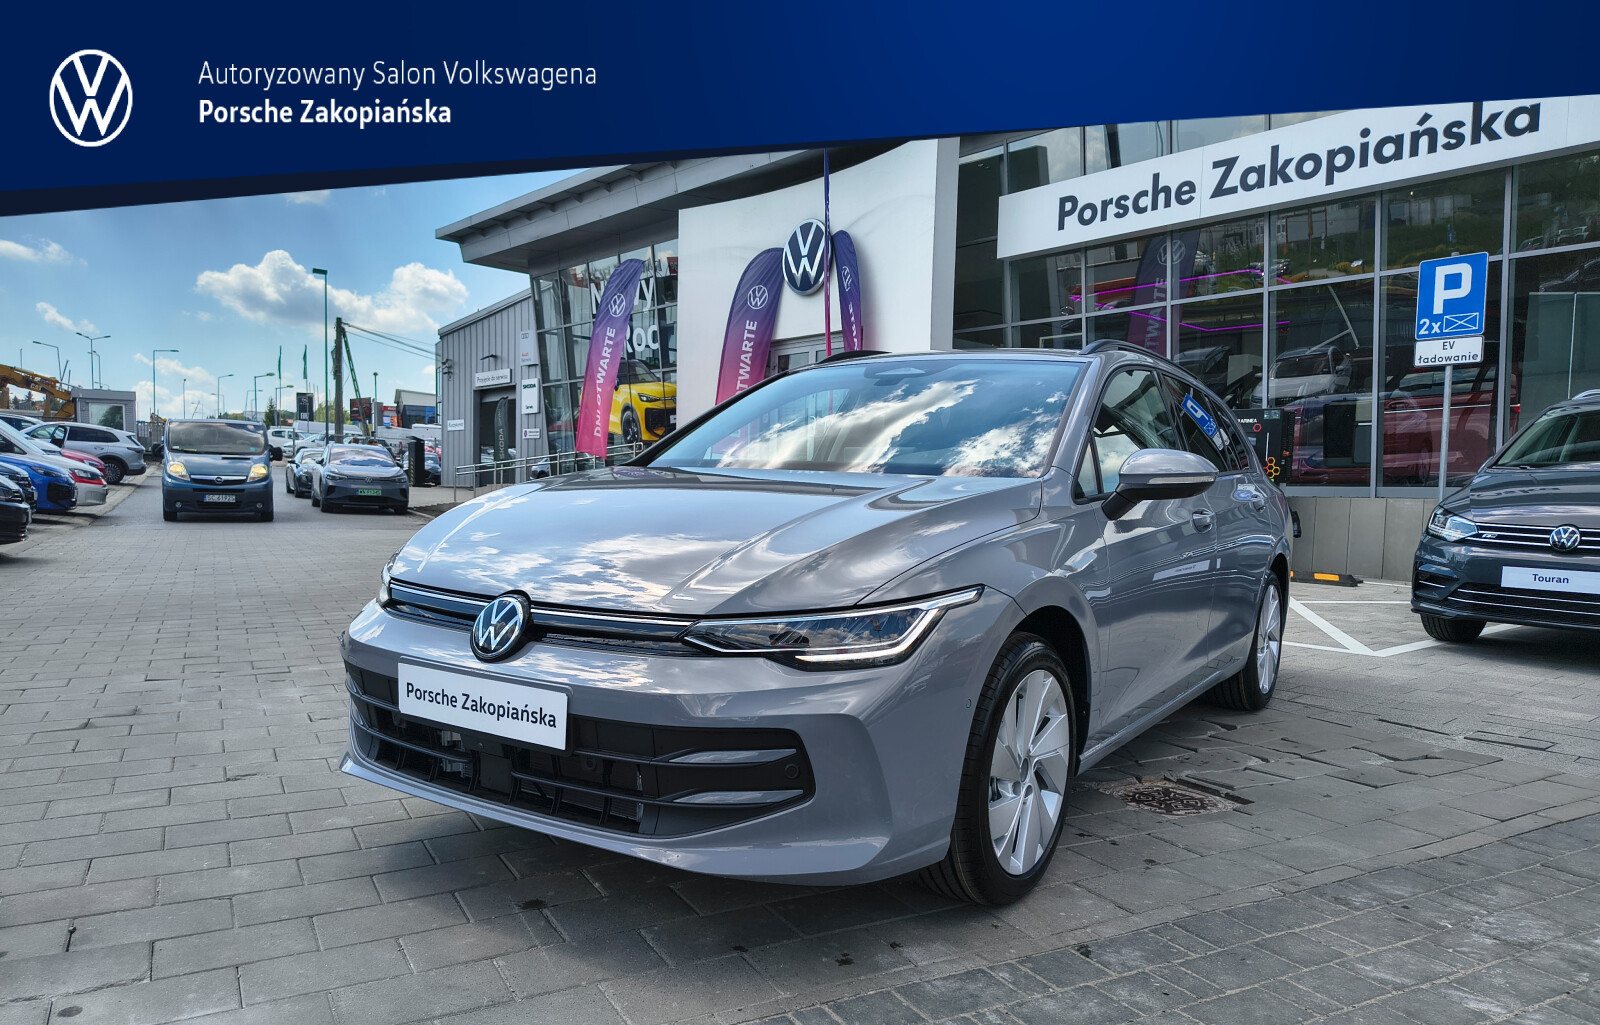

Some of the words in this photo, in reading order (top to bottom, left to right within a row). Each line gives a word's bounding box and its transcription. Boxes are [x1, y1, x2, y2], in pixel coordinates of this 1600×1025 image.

[1057, 172, 1197, 231] Porsche
[1209, 101, 1541, 199] Zakopiańska
[1433, 263, 1472, 315] P
[1418, 318, 1442, 335] 2x
[736, 319, 758, 395] TWARTE
[1418, 351, 1479, 364] ładowanie
[1442, 340, 1456, 351] EV
[1531, 573, 1569, 584] Touran
[406, 681, 458, 708] Porsche
[461, 692, 557, 729] Zakopiańska
